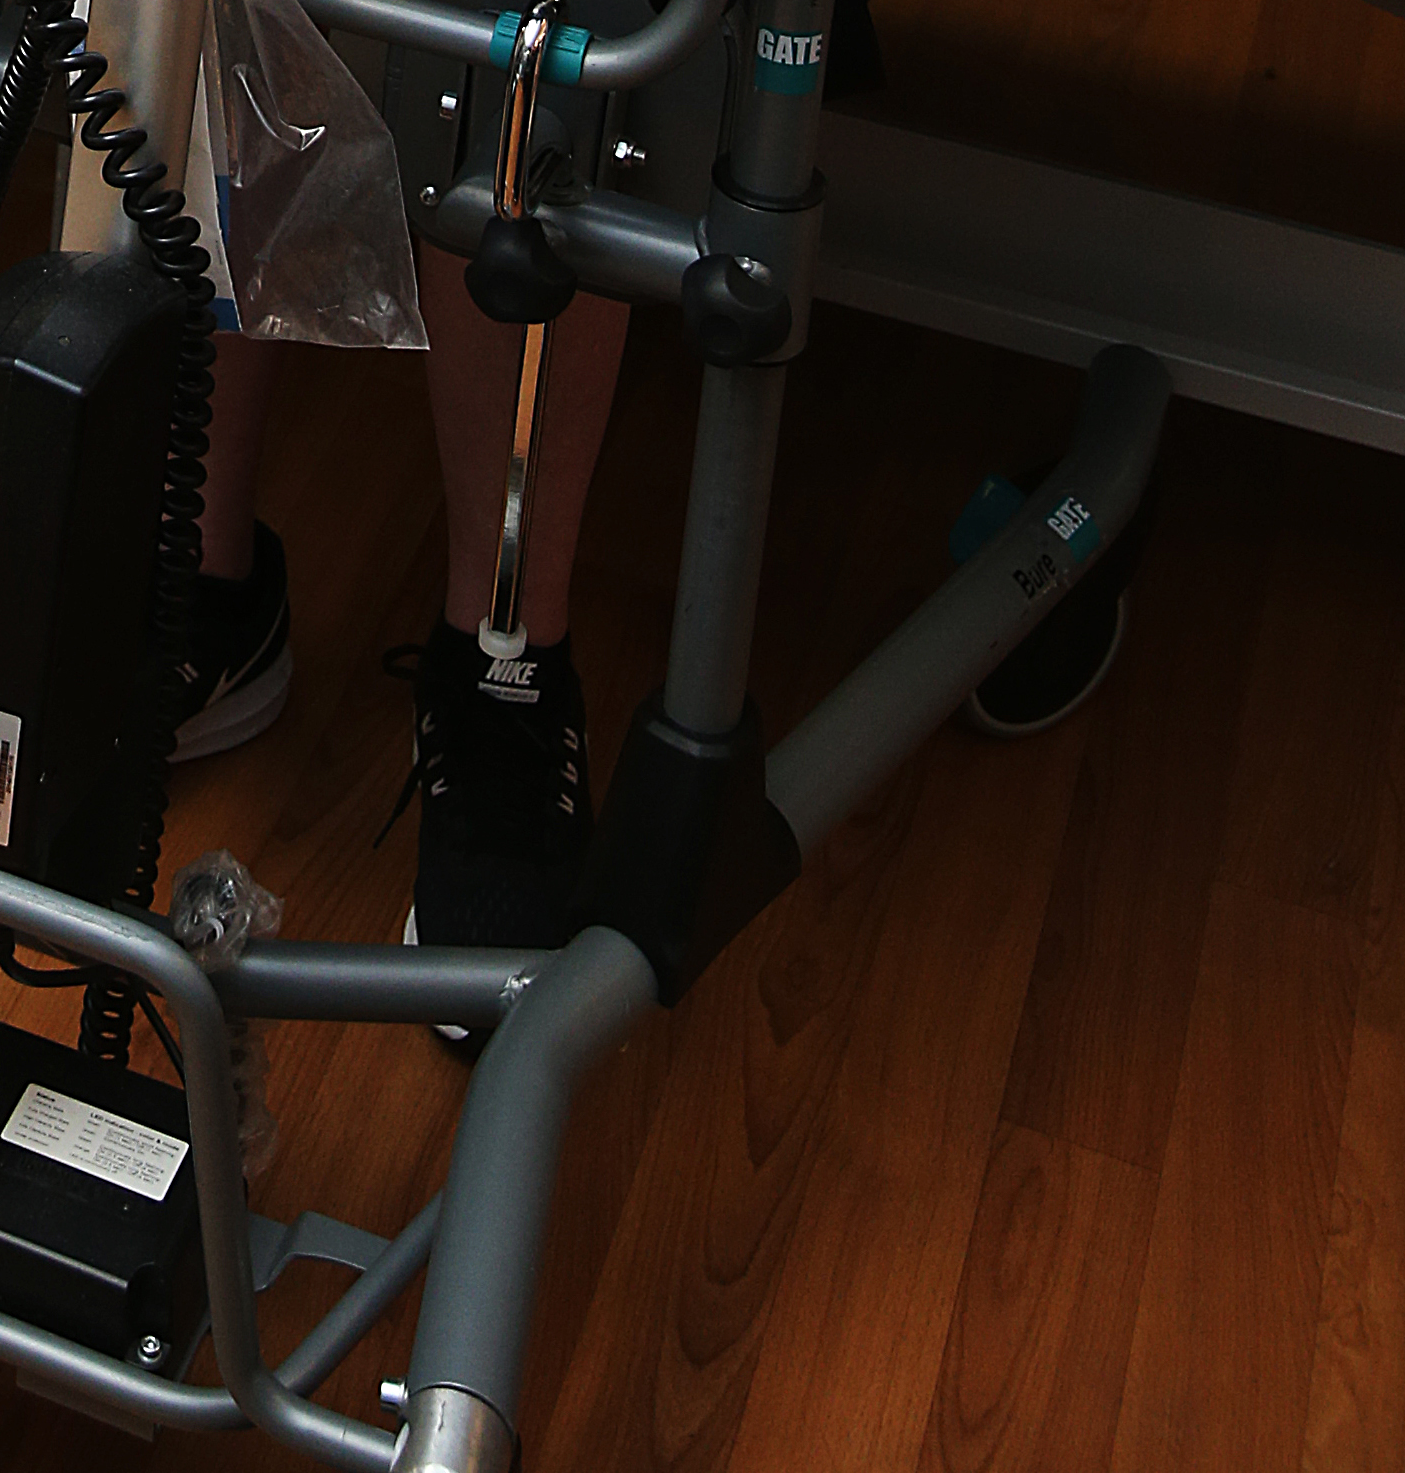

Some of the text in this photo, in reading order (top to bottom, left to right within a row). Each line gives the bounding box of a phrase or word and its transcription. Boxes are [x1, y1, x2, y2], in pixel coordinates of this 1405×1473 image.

[757, 28, 823, 66] GATE
[1046, 497, 1091, 541] GATE
[1012, 554, 1057, 600] Bure
[485, 658, 538, 685] NIKE
